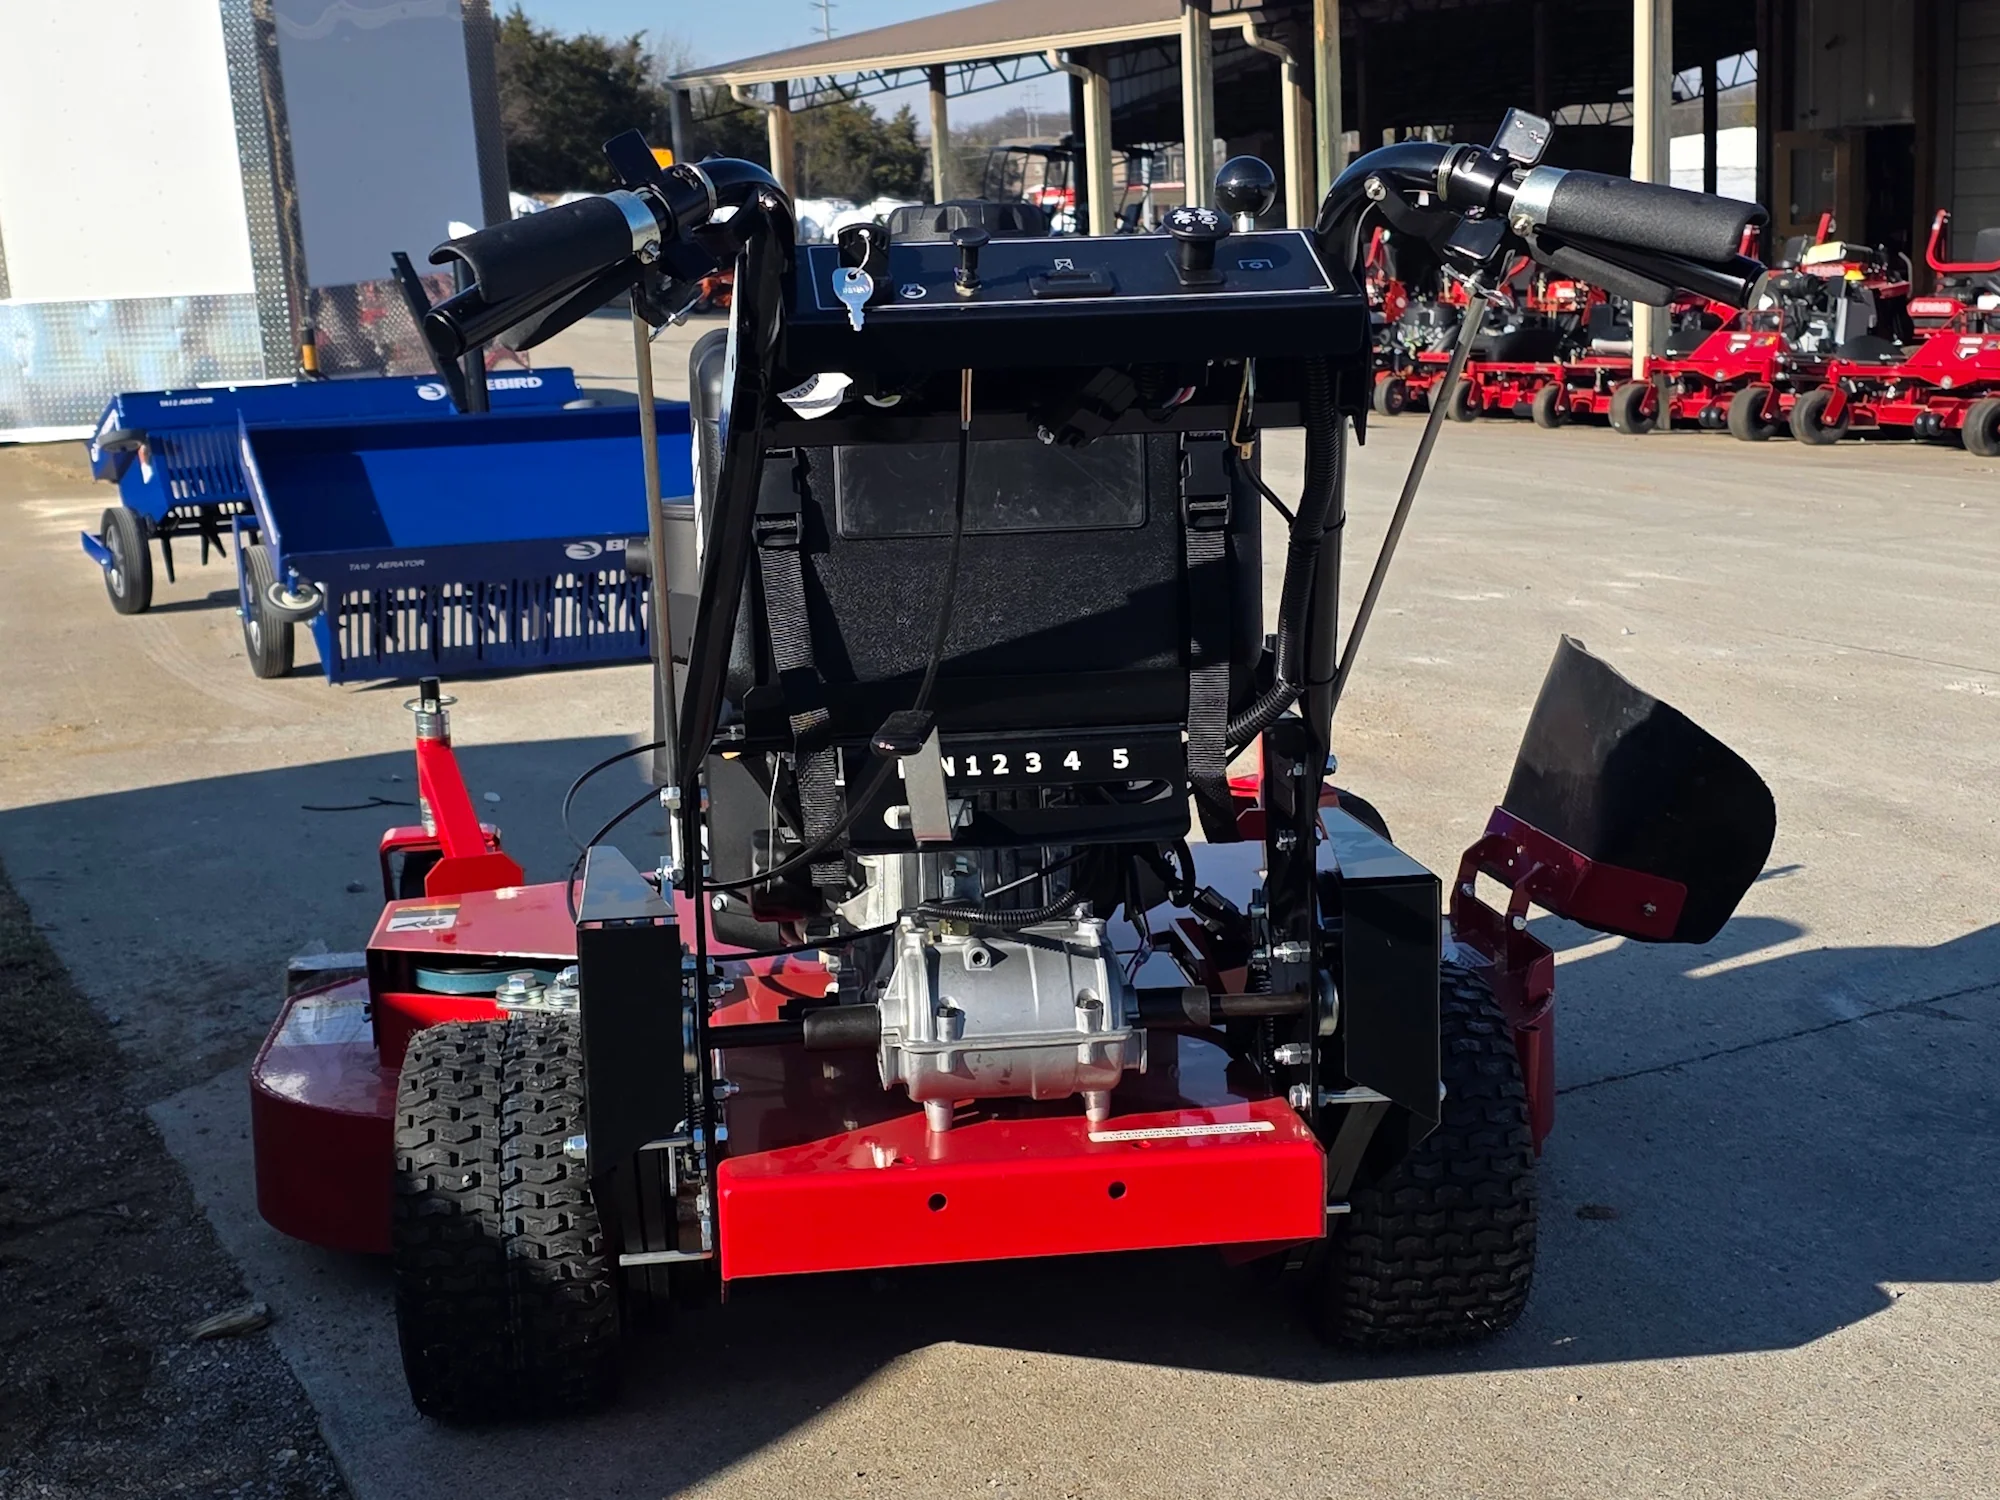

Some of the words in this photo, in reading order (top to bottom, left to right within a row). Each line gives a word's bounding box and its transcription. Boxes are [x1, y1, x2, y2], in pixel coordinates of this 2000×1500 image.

[486, 376, 543, 391] EBIRD
[376, 559, 425, 569] AERATOR
[965, 755, 982, 776] 1
[992, 753, 1010, 775] 2
[1025, 752, 1042, 773] 3
[1063, 750, 1082, 771] 4
[1112, 748, 1130, 769] 5
